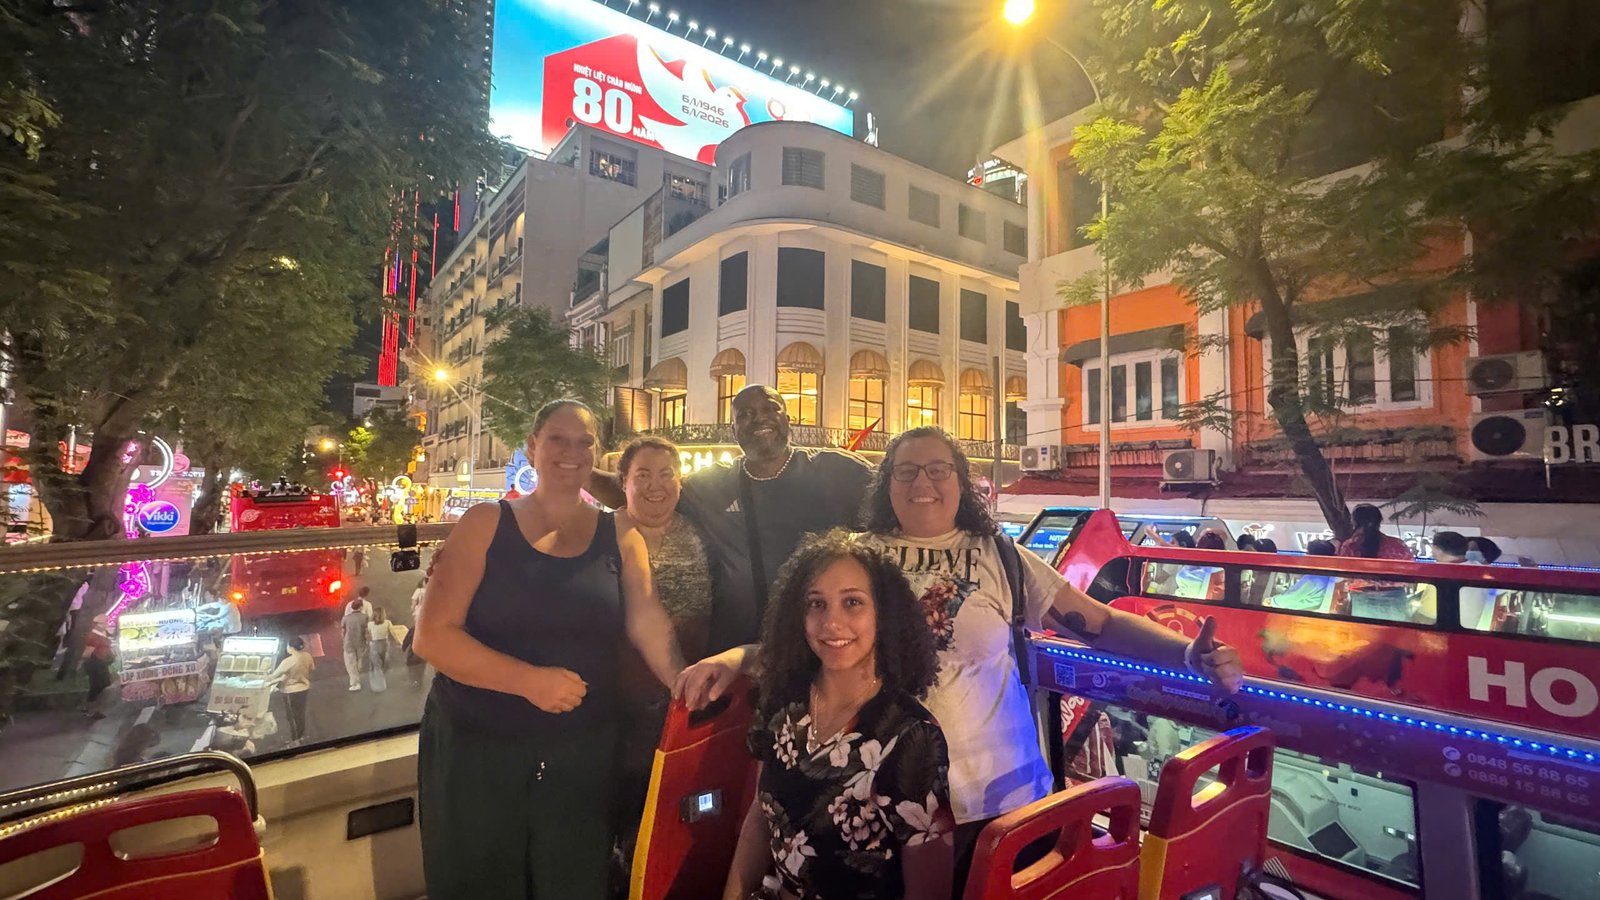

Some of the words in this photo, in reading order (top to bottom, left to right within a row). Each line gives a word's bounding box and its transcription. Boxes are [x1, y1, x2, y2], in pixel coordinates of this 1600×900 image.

[573, 63, 592, 77] NHIỆT
[593, 70, 607, 83] LIỆT
[572, 77, 633, 134] 80
[682, 105, 729, 128] 6/1/2026
[143, 508, 174, 521] Vikki
[1468, 655, 1599, 718] HO
[1467, 752, 1507, 771] 0848
[1512, 762, 1534, 776] 55
[1538, 767, 1561, 782] 88
[1565, 773, 1590, 788] 65
